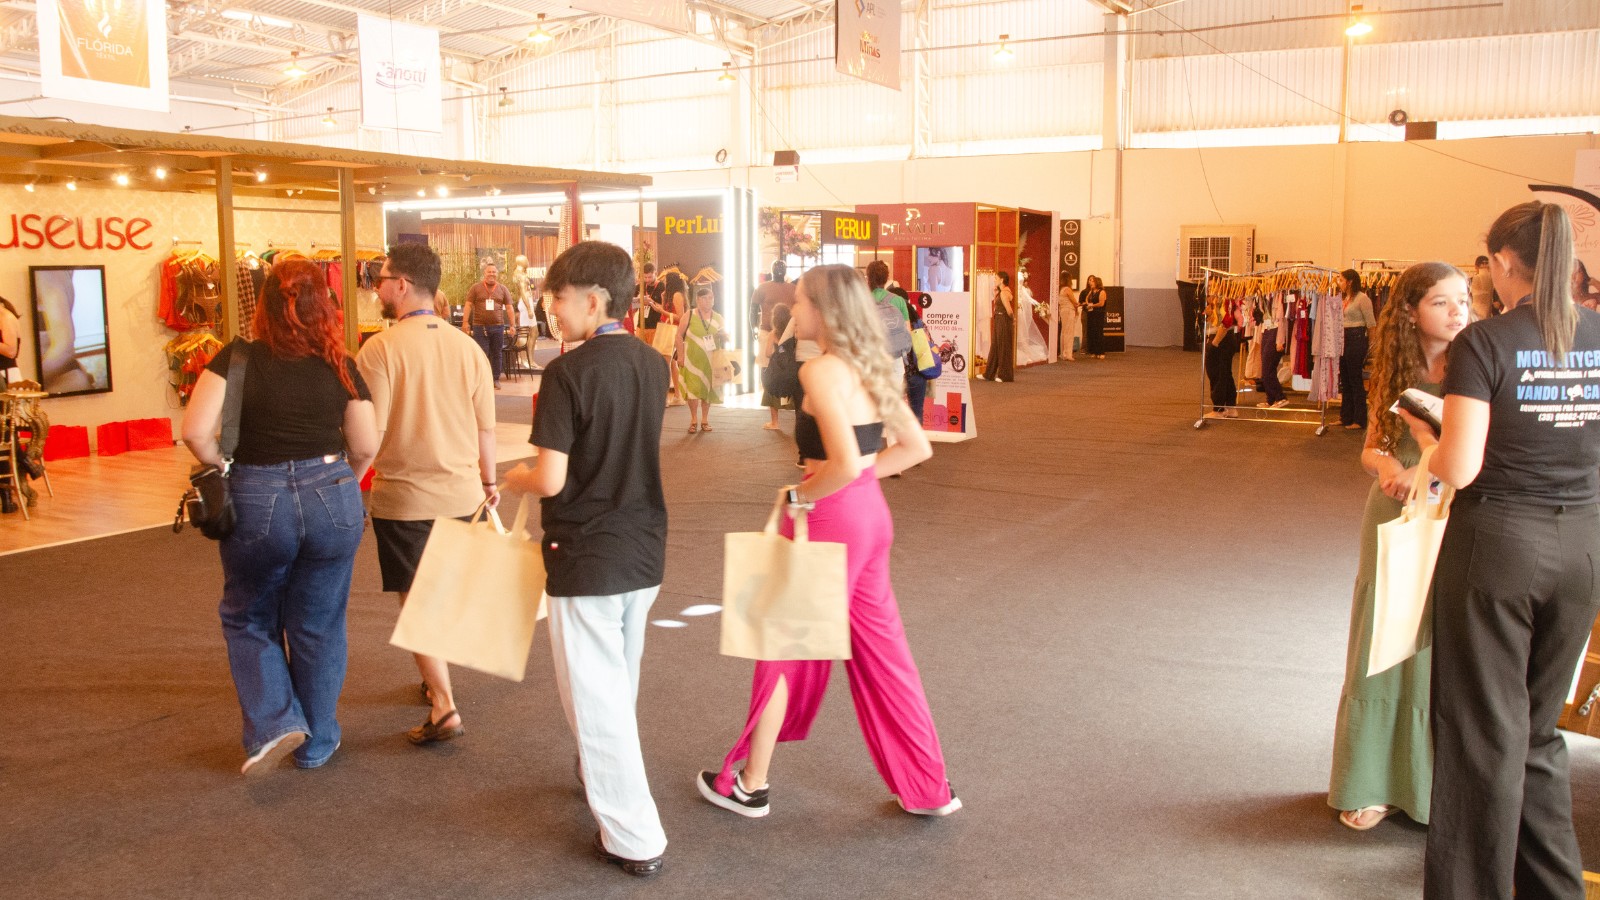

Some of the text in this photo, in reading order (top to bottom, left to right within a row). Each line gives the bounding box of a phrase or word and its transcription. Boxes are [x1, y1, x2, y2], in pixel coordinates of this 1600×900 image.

[77, 37, 134, 57] FLÓRIDA
[835, 217, 871, 240] PERLUI
[926, 313, 954, 321] compre
[1517, 385, 1559, 400] VANDO
